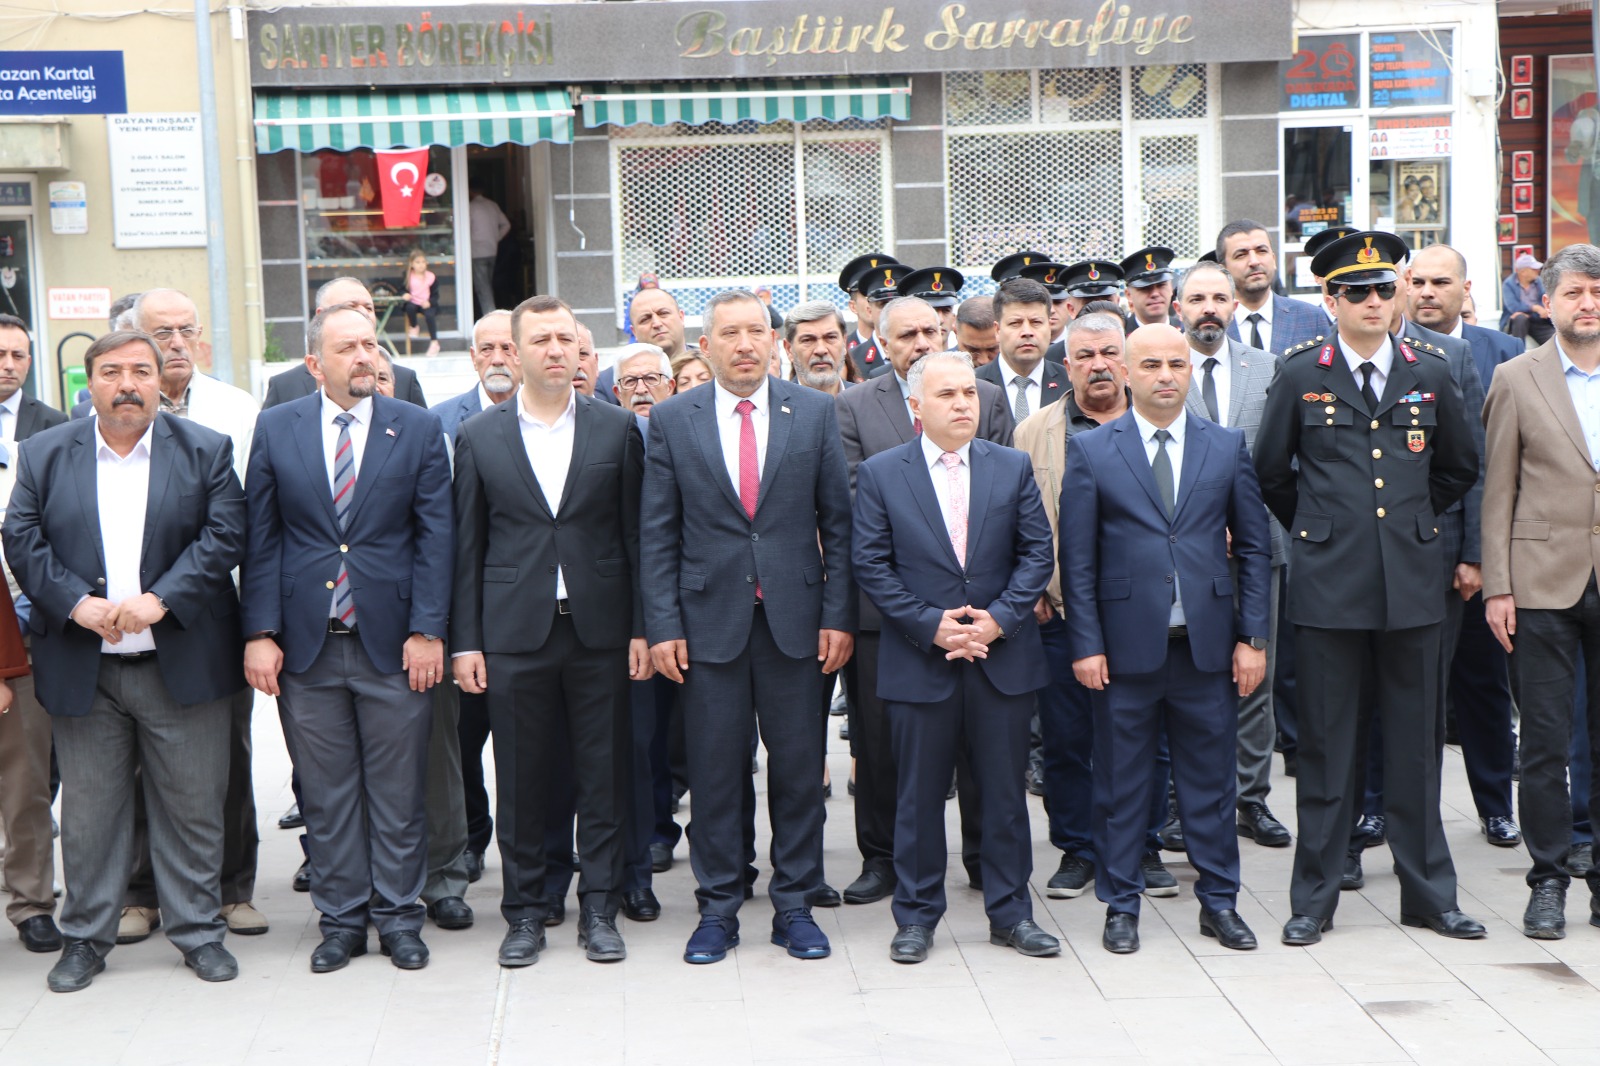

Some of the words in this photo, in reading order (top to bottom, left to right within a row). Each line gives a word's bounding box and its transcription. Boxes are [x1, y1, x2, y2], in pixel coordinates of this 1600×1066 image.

[674, 5, 910, 68] Baştürk
[923, 0, 1196, 57] Sarrafiye
[259, 22, 389, 70] SARIYER
[395, 10, 554, 77] BÖREKÇİSİ
[44, 65, 95, 81] Kartal
[17, 85, 97, 103] Acenteliği
[1289, 91, 1348, 109] DIGITAL
